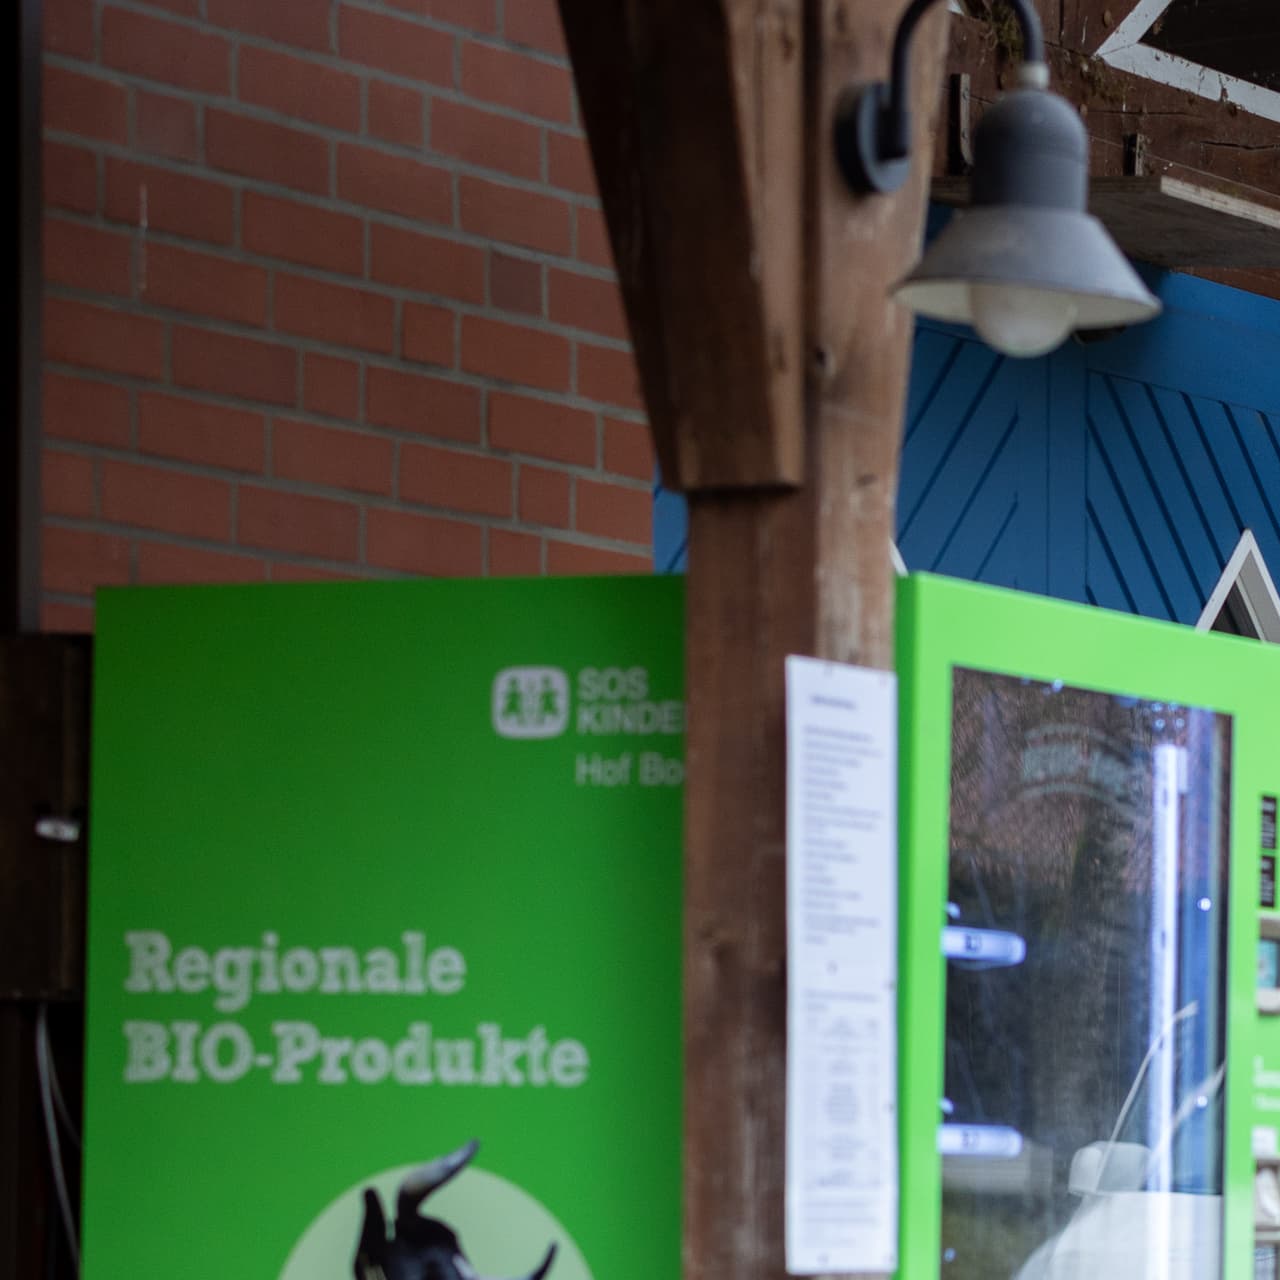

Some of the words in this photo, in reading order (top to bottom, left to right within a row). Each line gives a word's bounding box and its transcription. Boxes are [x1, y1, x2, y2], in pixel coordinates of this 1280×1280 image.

[578, 666, 649, 701] SOS
[575, 751, 632, 786] Hof
[124, 930, 467, 1012] Regionale
[124, 1021, 589, 1087] BIO-Produkte
